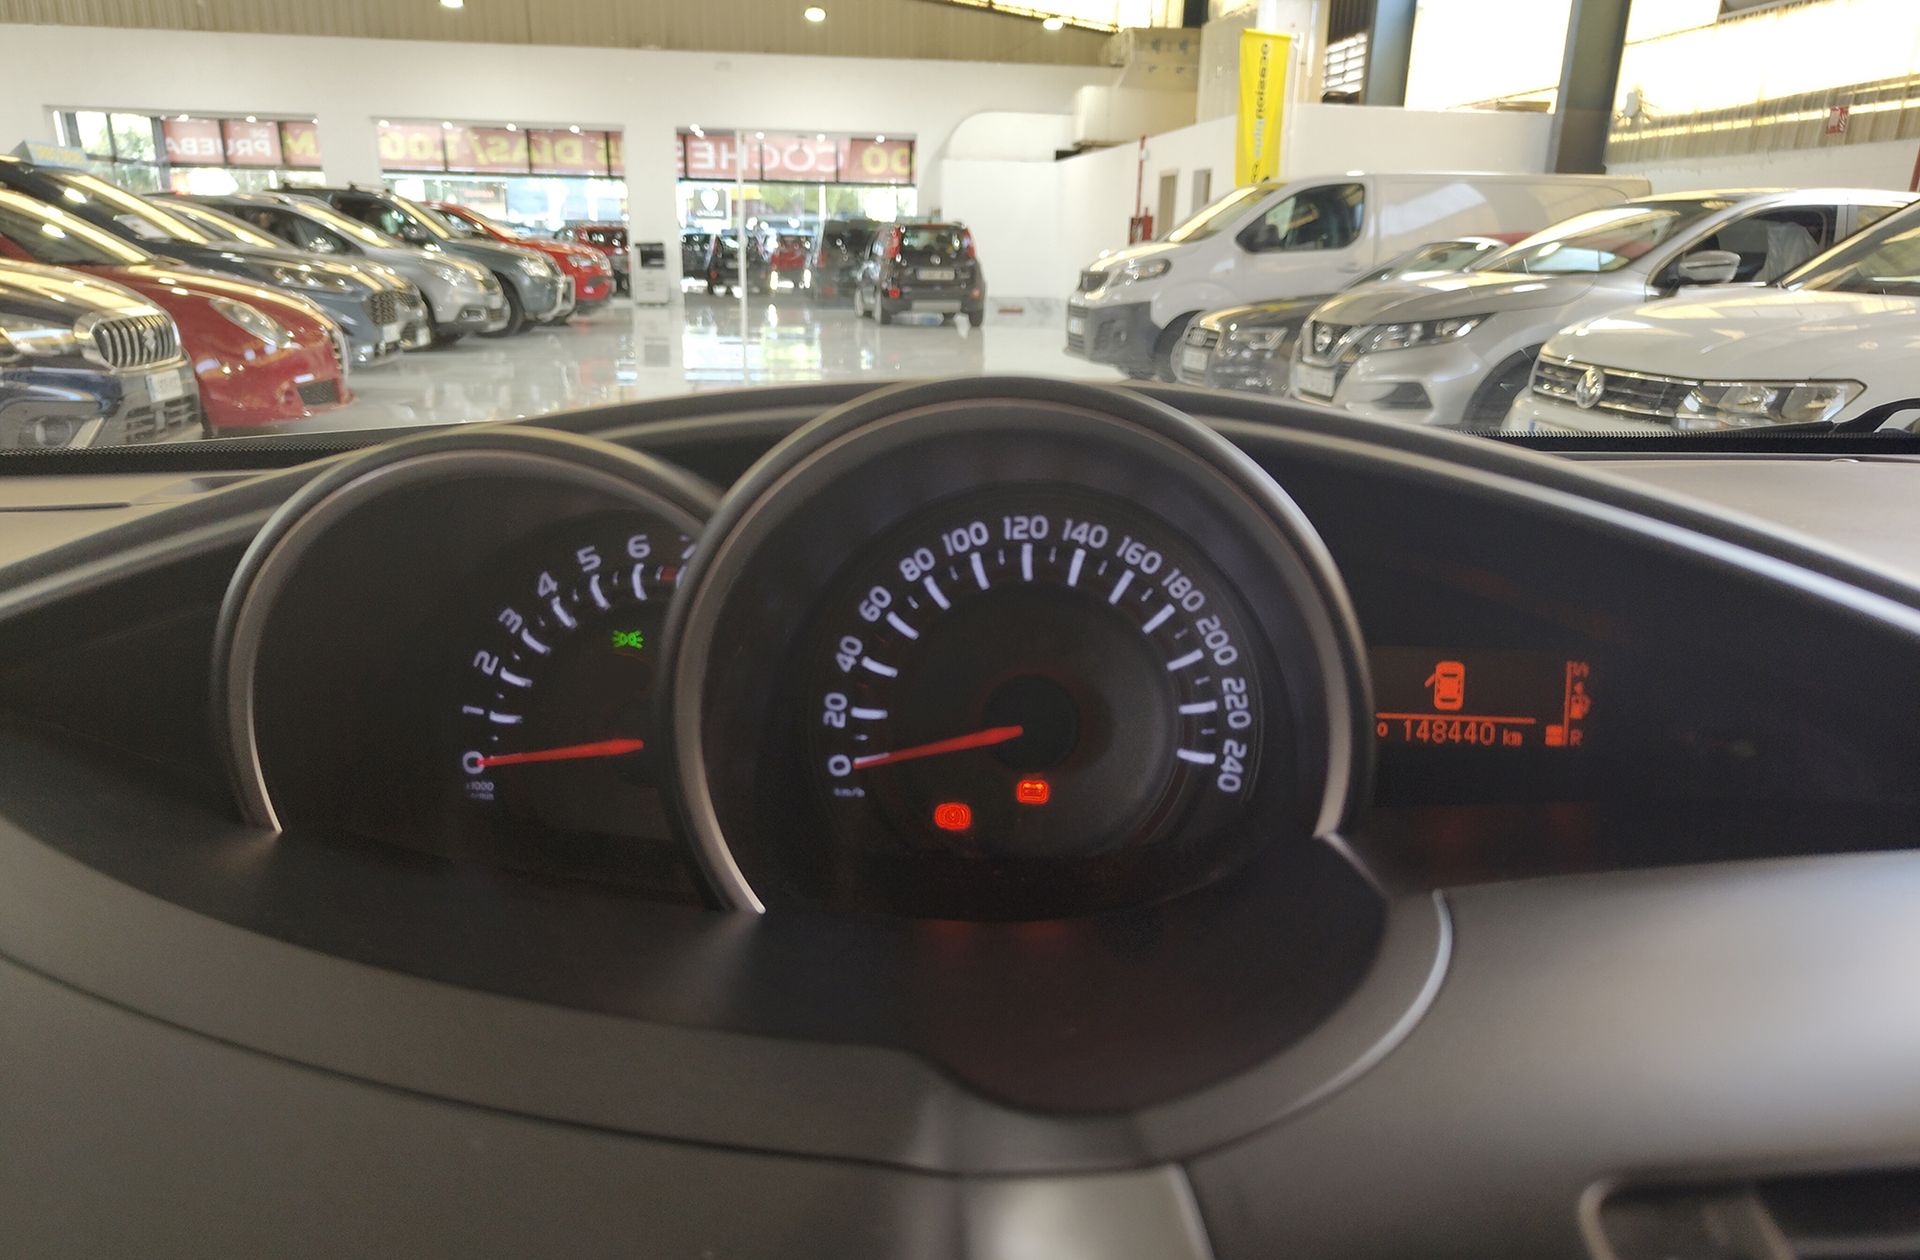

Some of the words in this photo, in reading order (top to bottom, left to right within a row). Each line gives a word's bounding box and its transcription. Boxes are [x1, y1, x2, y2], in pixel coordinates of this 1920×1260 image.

[942, 521, 990, 557] 100
[1003, 515, 1049, 540] 120
[1062, 518, 1109, 550] 140
[576, 545, 602, 573] 5
[627, 534, 651, 559] 6
[1116, 536, 1163, 575] 160
[899, 547, 936, 583] 80
[536, 571, 558, 598] 4
[1161, 569, 1205, 612] 180
[499, 607, 524, 634] 3
[859, 585, 892, 622] 60
[835, 635, 863, 673] 40
[1195, 615, 1238, 666] 200
[473, 650, 499, 676] 2
[823, 692, 848, 729] 20
[1221, 677, 1252, 730] 220
[1403, 719, 1496, 746] 148440
[1502, 728, 1523, 747] km
[462, 750, 485, 775] 0
[828, 754, 851, 777] 0
[1216, 739, 1247, 793] 240
